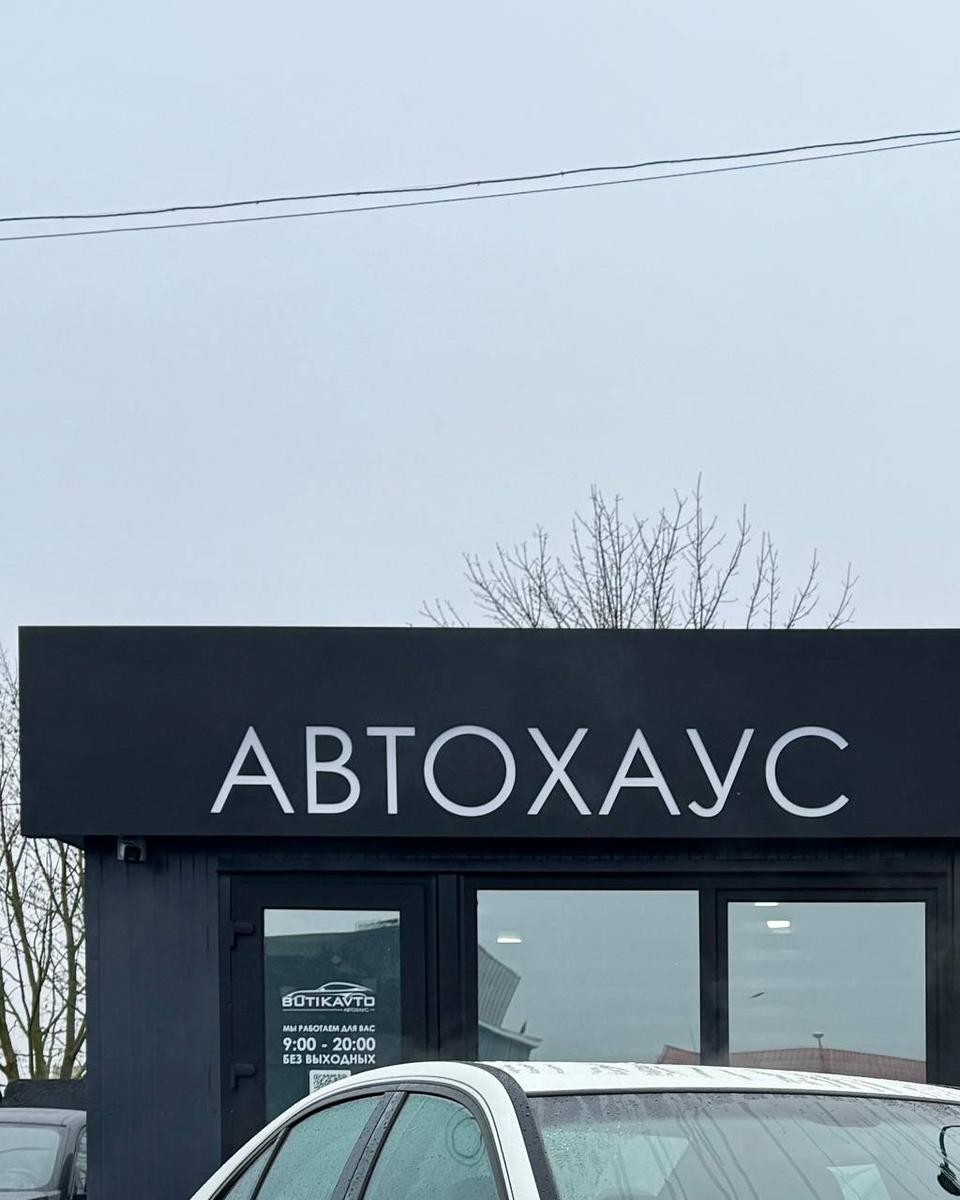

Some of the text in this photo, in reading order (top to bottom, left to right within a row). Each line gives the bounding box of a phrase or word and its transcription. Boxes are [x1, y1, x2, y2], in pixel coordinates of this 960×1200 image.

[210, 725, 850, 818] АВТОХАУС
[282, 995, 375, 1007] BUTIKAVTO
[282, 1024, 376, 1033] МЫ РАБОТАЕМ ДЛЯ ВАС
[283, 1037, 317, 1051] 9:00
[332, 1037, 376, 1051] 20:00
[282, 1054, 376, 1065] БЕЗ ВЫХОДНЫХ
